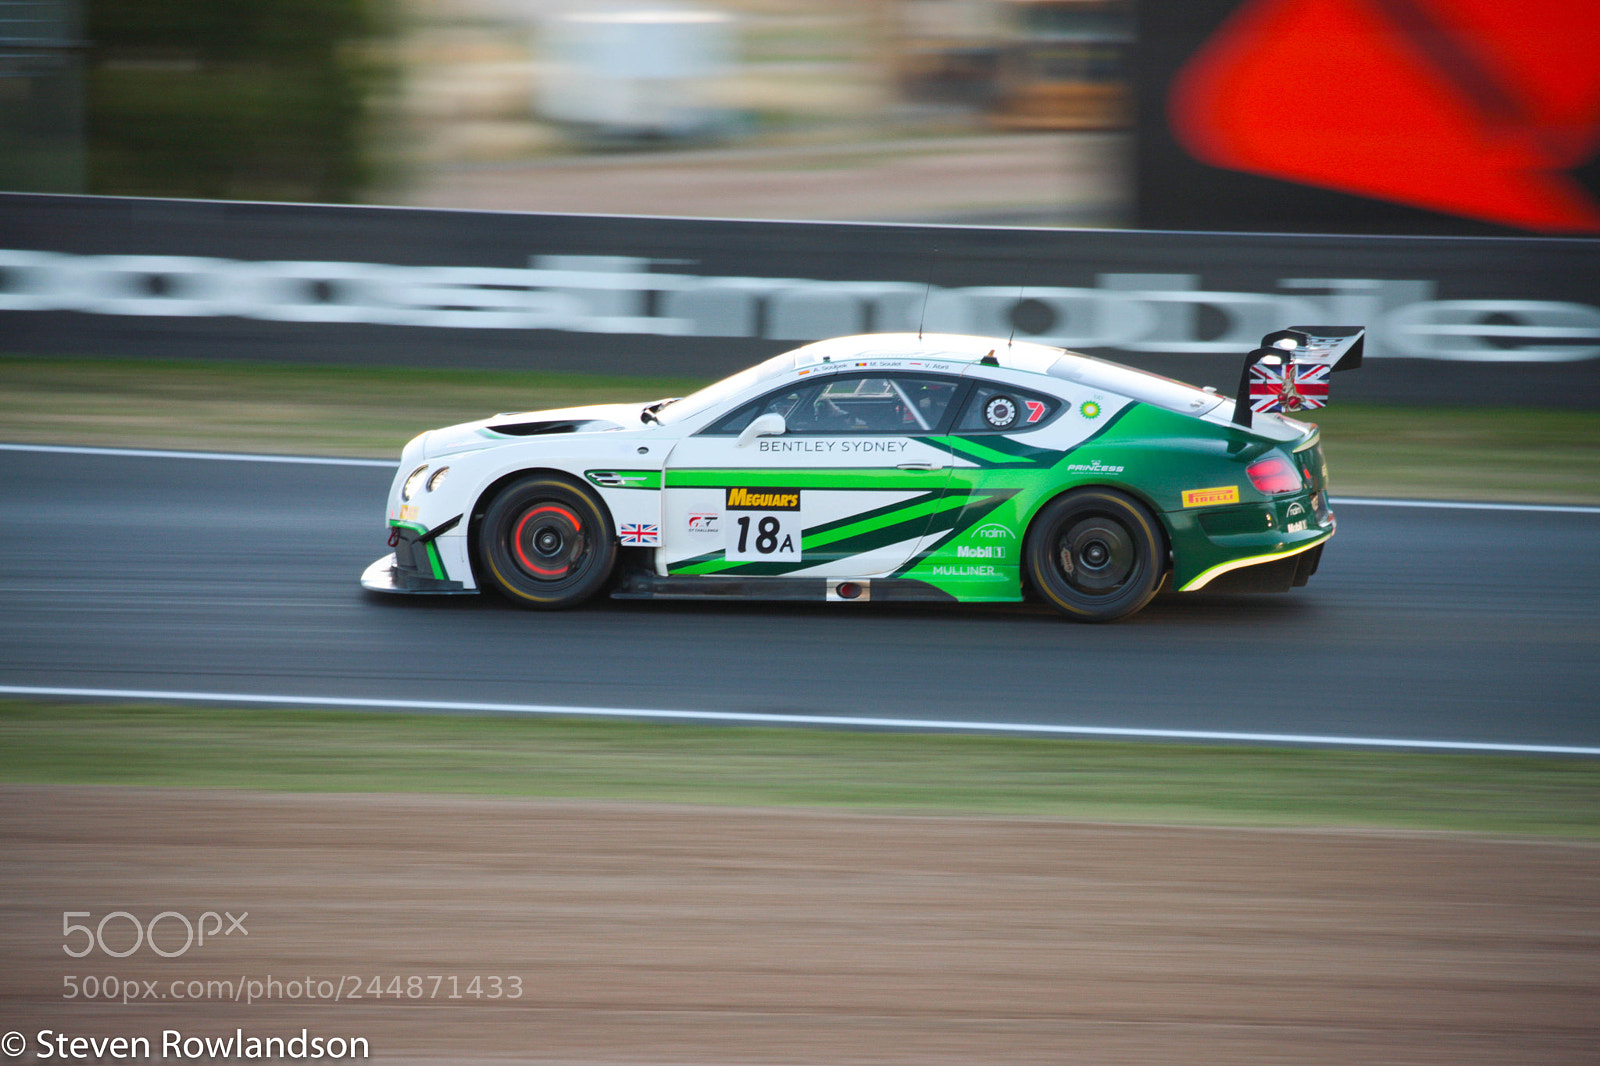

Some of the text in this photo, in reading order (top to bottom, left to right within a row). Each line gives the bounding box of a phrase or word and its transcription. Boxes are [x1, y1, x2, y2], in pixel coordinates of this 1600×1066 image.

[760, 441, 908, 452] BENTLEY SYDNEY
[1067, 465, 1125, 473] PRINCESS
[1188, 489, 1234, 504] PIRELLI
[957, 545, 992, 559] Mobil
[933, 566, 995, 576] MULLINER
